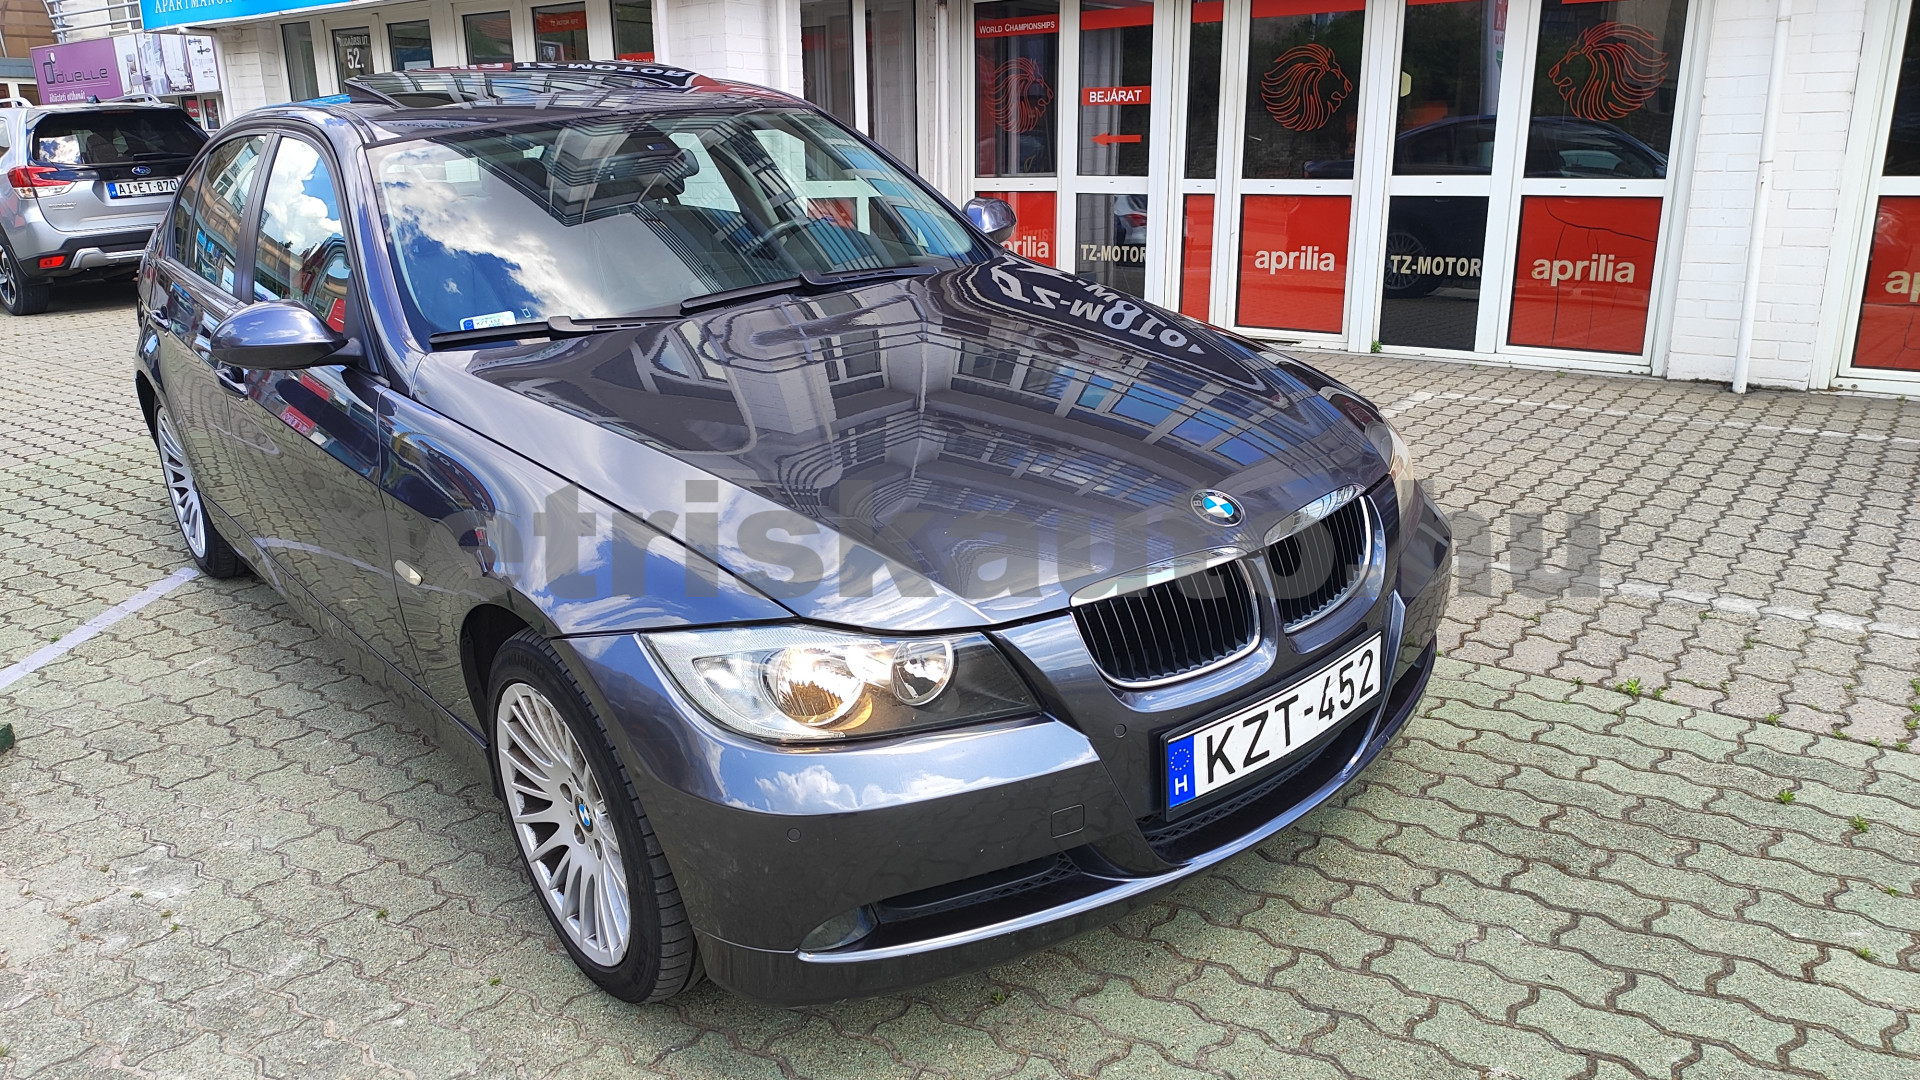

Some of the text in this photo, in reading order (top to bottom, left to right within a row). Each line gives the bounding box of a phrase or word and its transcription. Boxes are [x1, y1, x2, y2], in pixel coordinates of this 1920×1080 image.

[347, 48, 364, 69] 52.
[1089, 88, 1143, 103] BEJÁRAT
[1000, 235, 1049, 259] prilia
[1081, 244, 1147, 263] TZ-MOTOR
[1254, 245, 1336, 275] aprilia
[1390, 255, 1482, 278] TZ-MOTOR
[1531, 253, 1636, 287] aprilia
[1206, 649, 1374, 784] KZT-452
[1174, 774, 1188, 796] H
